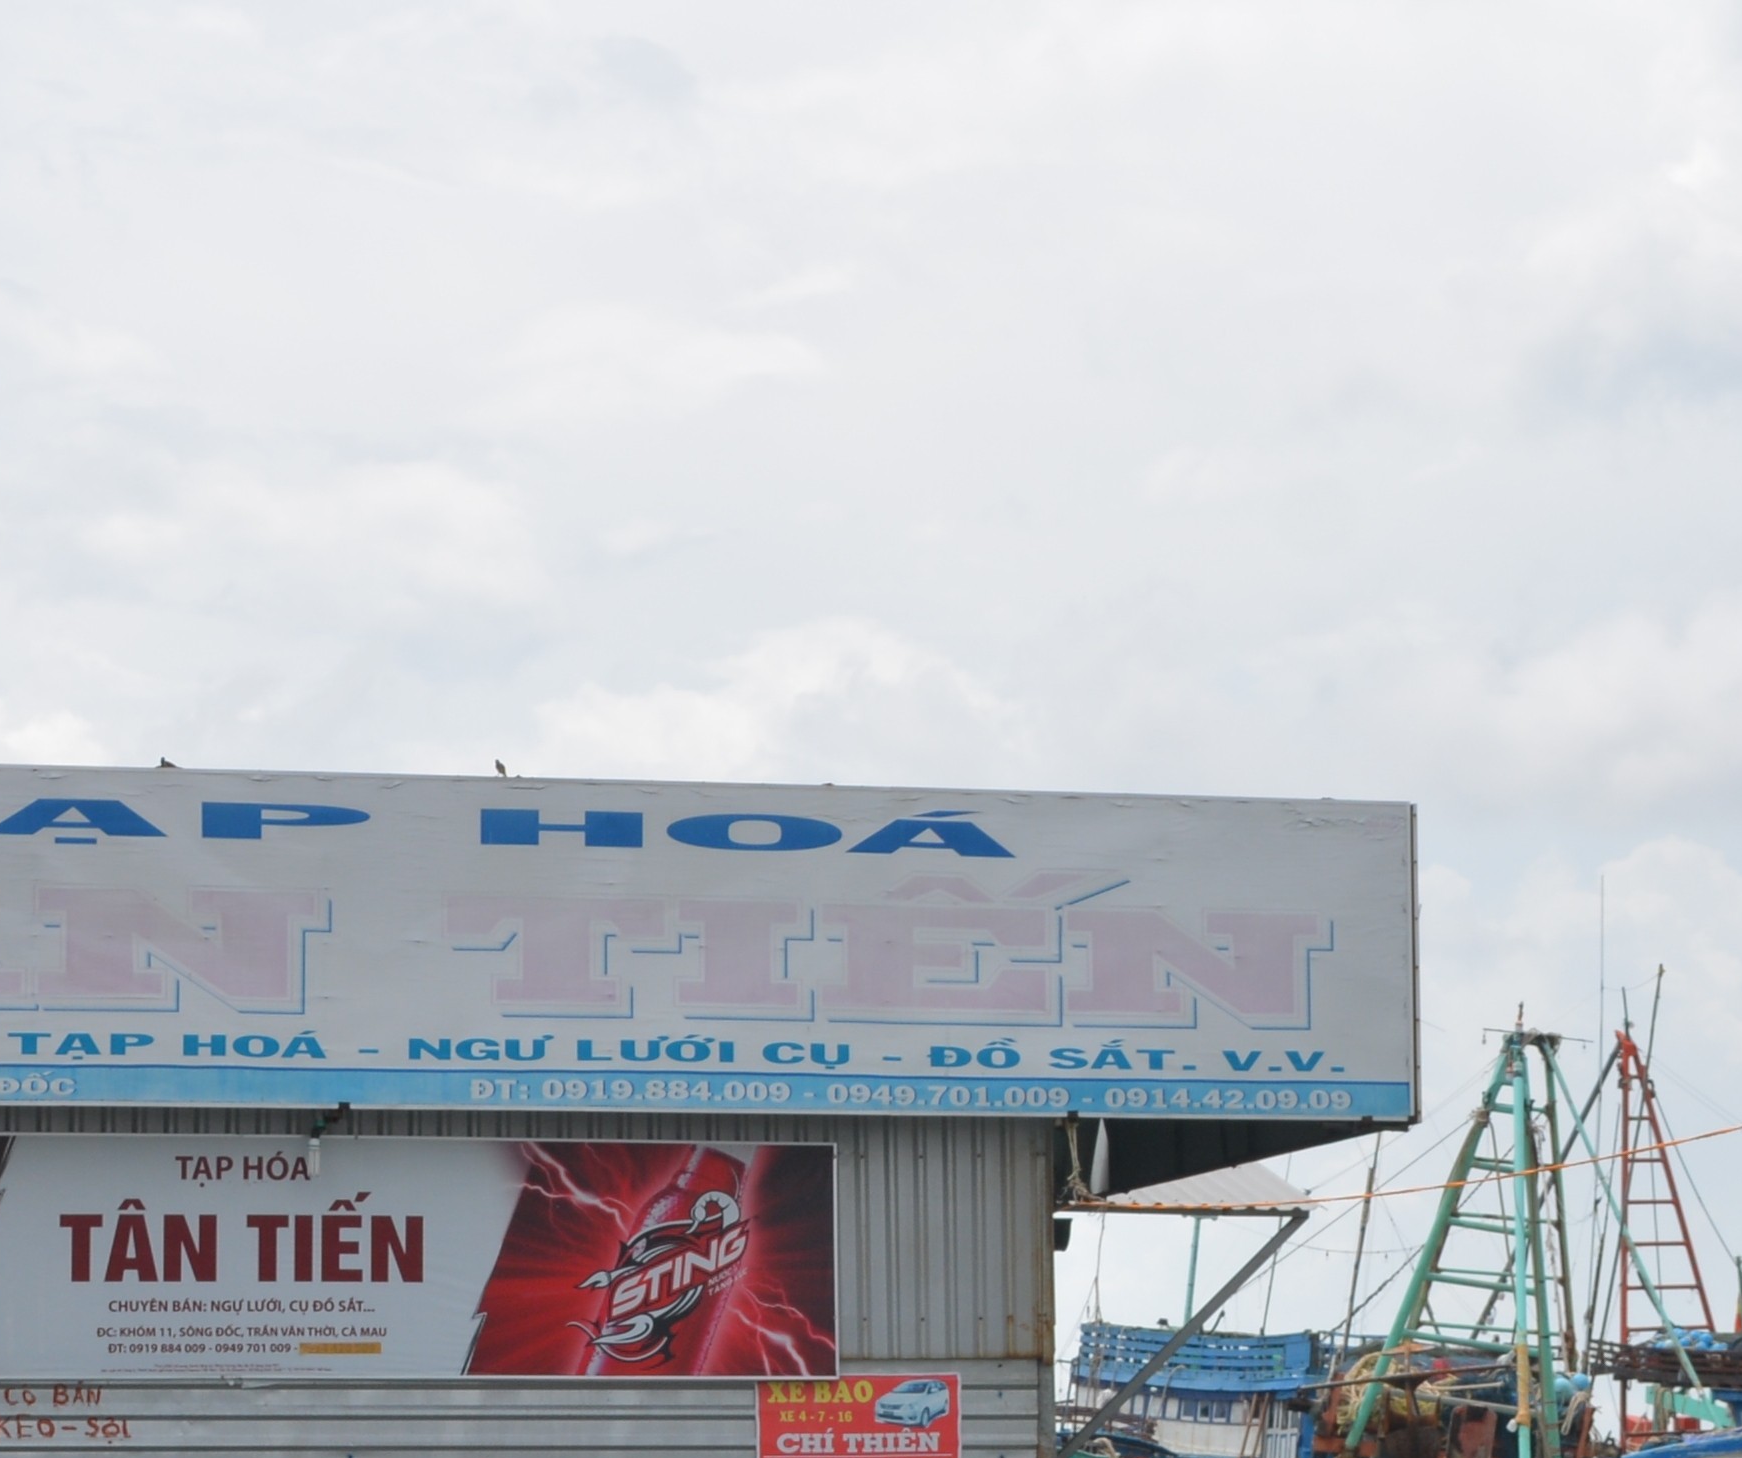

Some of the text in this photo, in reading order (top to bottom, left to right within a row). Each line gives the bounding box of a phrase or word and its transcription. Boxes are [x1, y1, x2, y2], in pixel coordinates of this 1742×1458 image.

[481, 809, 1016, 858] HOÁ
[443, 869, 1334, 1029] TIẾN
[8, 1032, 154, 1060] TẠP
[183, 1030, 326, 1059] HOÁ
[408, 1035, 555, 1061] NGƯ
[576, 1034, 735, 1063] LƯỚI
[762, 1042, 850, 1069] CỤ
[928, 1038, 1021, 1069] ĐỒ
[1222, 1050, 1346, 1073] V.V.
[470, 1078, 531, 1100] ĐT:
[541, 1078, 792, 1103] 0919.884.009
[826, 1083, 1071, 1108] 0949.701.009
[1104, 1086, 1353, 1110] 0914.42.09.09
[175, 1151, 310, 1187] TẠP HÓA
[59, 1191, 424, 1283] TÂN TIẾN
[612, 1228, 747, 1316] STING
[108, 1298, 168, 1312] CHUYÊN
[172, 1297, 207, 1312] BÁN:
[210, 1299, 244, 1315] NGỰ
[247, 1298, 286, 1314] LƯỚI,
[289, 1300, 308, 1315] CỤ
[96, 1327, 117, 1337] ĐC:
[119, 1325, 156, 1337] KHÓM
[160, 1327, 176, 1338] 11,
[179, 1325, 213, 1337] SÔNG
[215, 1324, 244, 1338] ĐỐC,
[341, 1325, 357, 1337] CÀ
[360, 1327, 387, 1337] MAU
[108, 1343, 127, 1354] ĐT:
[129, 1343, 158, 1353] 0919
[160, 1343, 181, 1353] 884
[184, 1343, 206, 1353] 009
[215, 1343, 243, 1353] 0949
[247, 1343, 266, 1353] 701
[270, 1343, 291, 1353] 009
[53, 1380, 102, 1406] BÁN
[767, 1380, 874, 1403] XE BAO
[780, 1411, 794, 1422] XE
[798, 1411, 806, 1422] 4
[818, 1411, 824, 1422] 7
[838, 1411, 853, 1422] 16
[776, 1428, 940, 1454] CHÍ THIÊN
